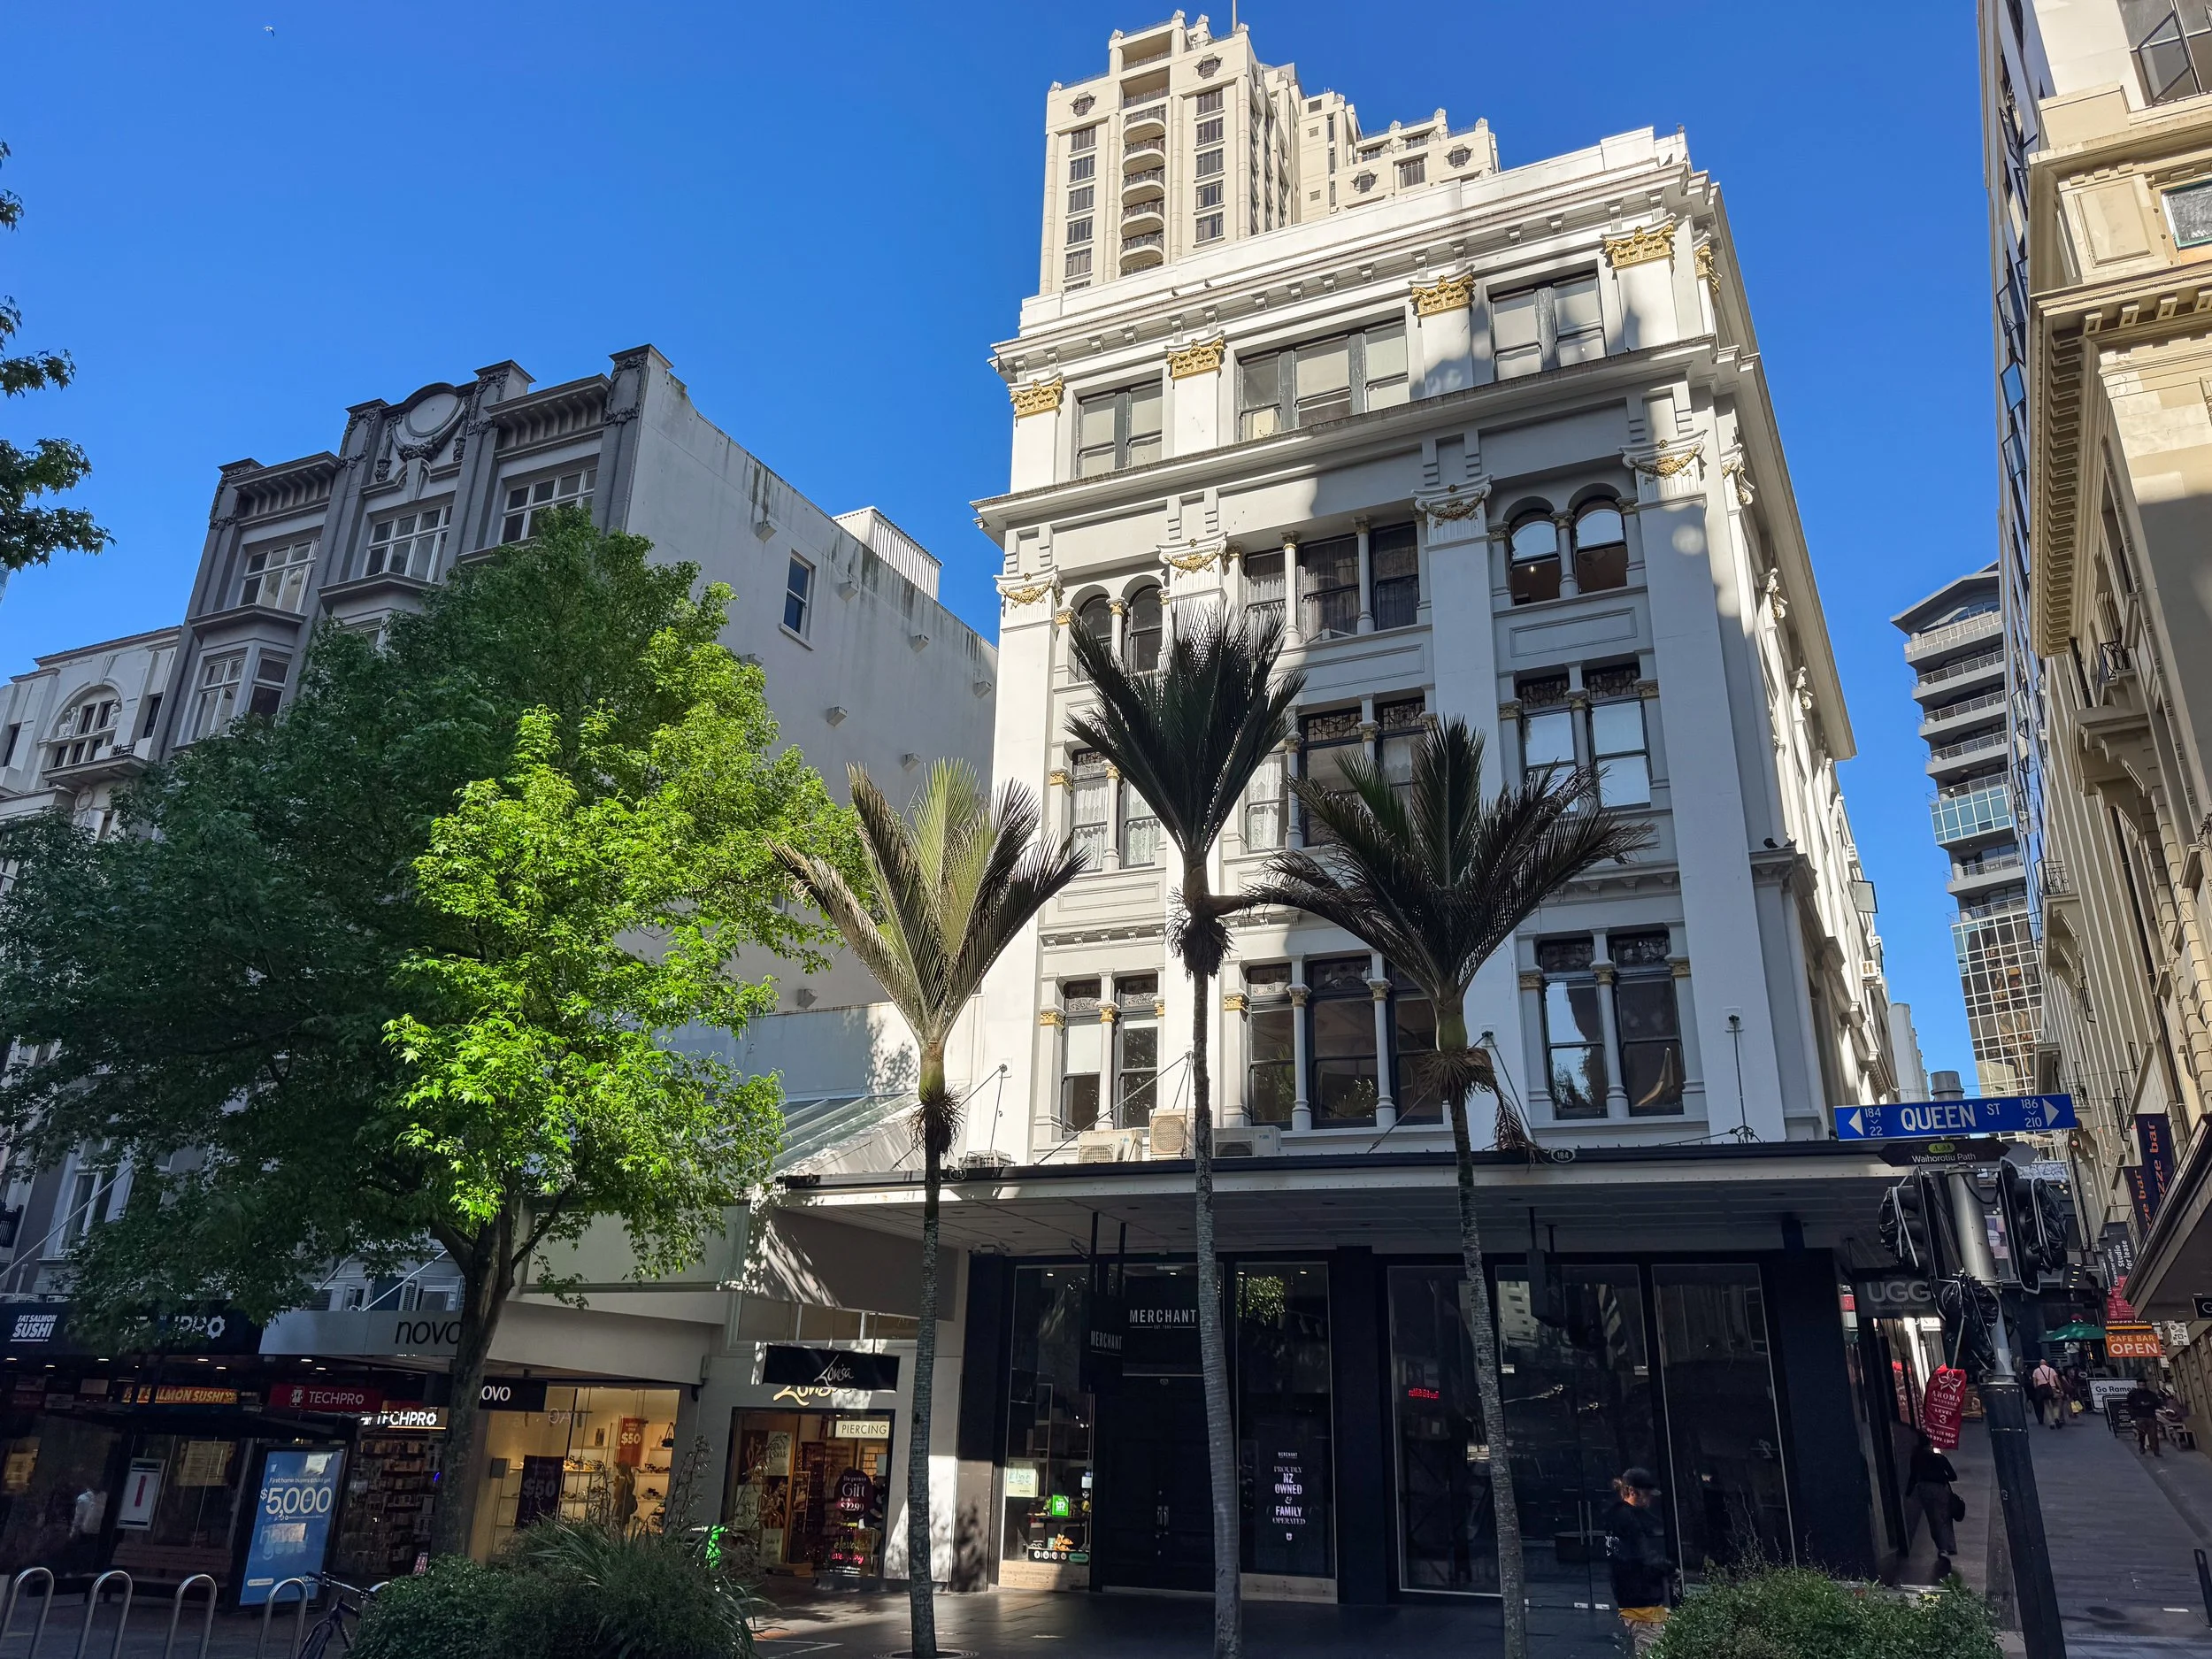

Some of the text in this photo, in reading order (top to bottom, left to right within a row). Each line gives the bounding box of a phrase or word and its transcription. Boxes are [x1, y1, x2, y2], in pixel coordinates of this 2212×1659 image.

[2021, 1099, 2039, 1109] 186
[1865, 1108, 1881, 1118] 184
[1901, 1103, 2001, 1132] QUEEN ST
[2024, 1118, 2042, 1127] 210
[1870, 1126, 1883, 1136] 22
[2147, 1121, 2159, 1153] bar
[1911, 1152, 1976, 1164] Waihorotiu Path
[2134, 1170, 2147, 1199] bar
[2114, 1245, 2125, 1267] Studio
[2121, 1240, 2131, 1258] lease
[1866, 1281, 1932, 1302] UGG
[1129, 1310, 1196, 1323] MERCHANT
[12, 1323, 54, 1338] SUSHI
[395, 1321, 463, 1345] novo
[1091, 1330, 1122, 1350] MERCHANT
[2111, 1343, 2158, 1355] OPEN
[814, 1354, 854, 1387] Lovisa
[191, 1390, 225, 1402] SUSHI
[309, 1390, 365, 1405] TECHPRO
[480, 1386, 511, 1402] ovo
[1932, 1390, 1961, 1402] AROMA
[1939, 1415, 1947, 1424] 3
[841, 1424, 887, 1435] PIERCING
[621, 1432, 641, 1446] $50
[1283, 1473, 1294, 1484] NZ
[523, 1478, 556, 1499] $50
[841, 1482, 865, 1497] Gift
[1275, 1483, 1302, 1494] OWNED
[260, 1486, 333, 1518] $5,000
[1275, 1506, 1302, 1517] FAMILY
[1272, 1517, 1306, 1525] OPERATED
